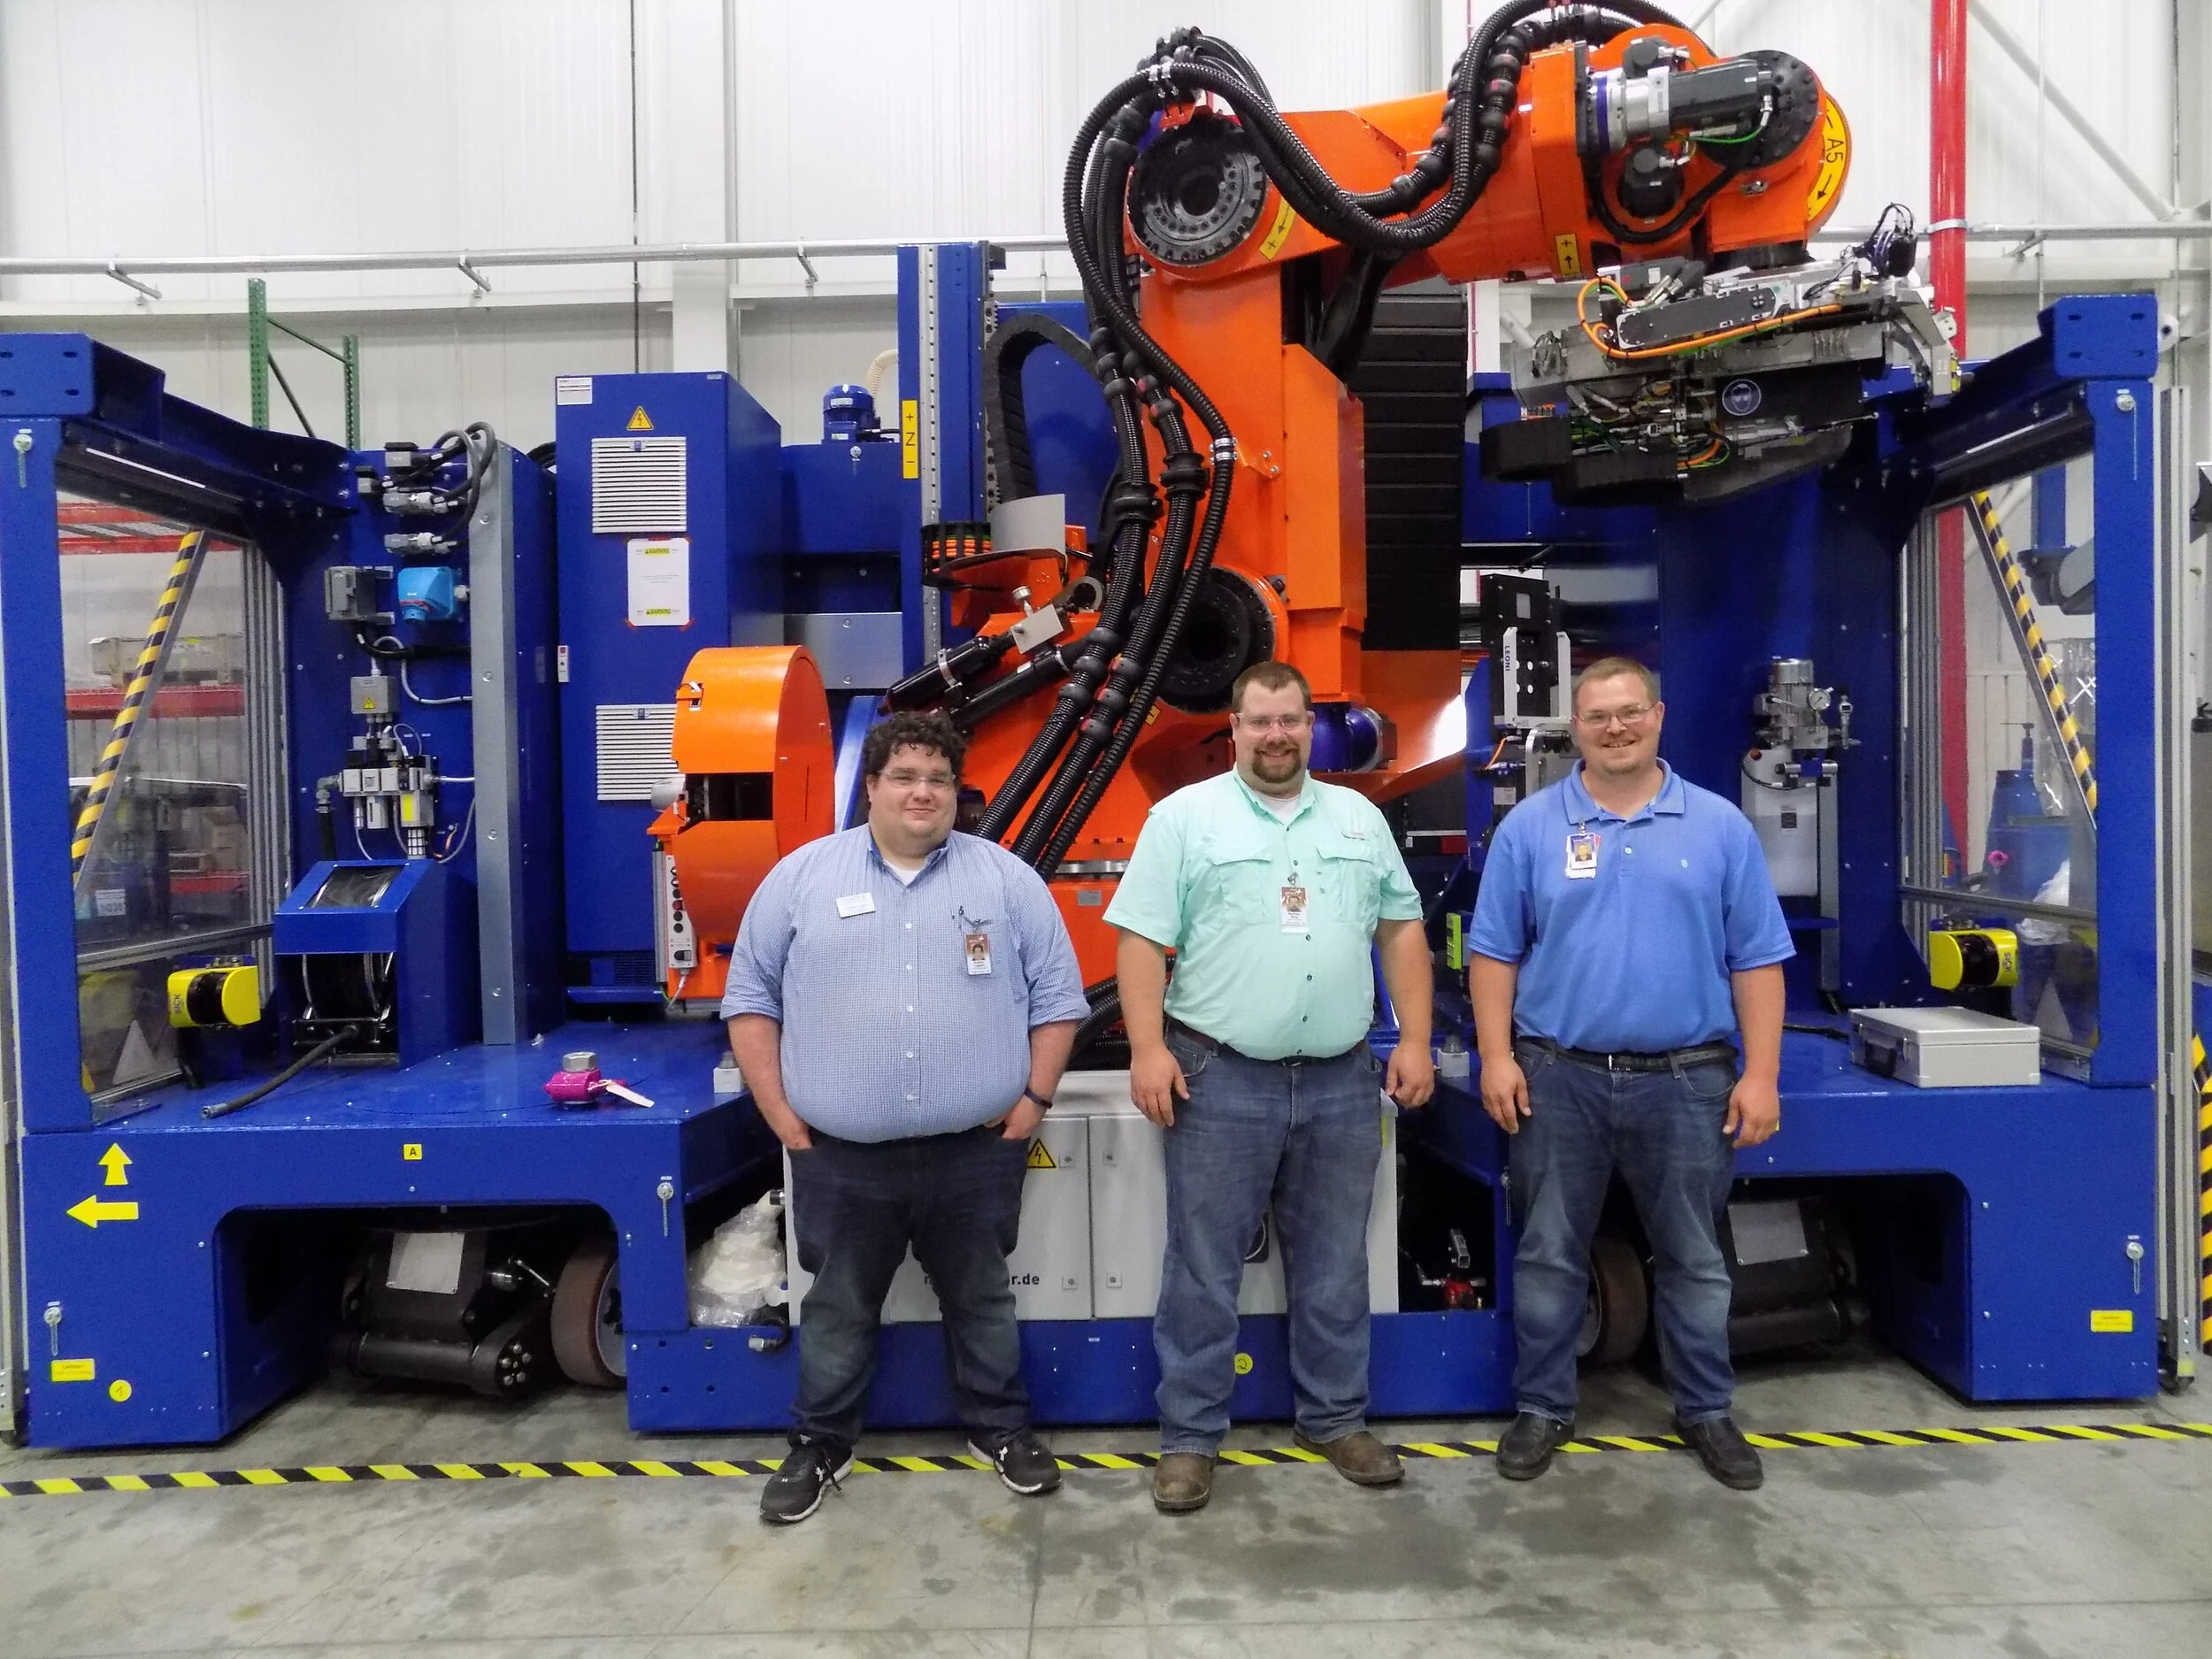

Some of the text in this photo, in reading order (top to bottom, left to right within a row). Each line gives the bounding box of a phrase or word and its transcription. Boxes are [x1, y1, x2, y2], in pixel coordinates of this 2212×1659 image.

[1826, 138, 1844, 163] A5
[905, 432, 915, 446] Z
[410, 1147, 417, 1156] A
